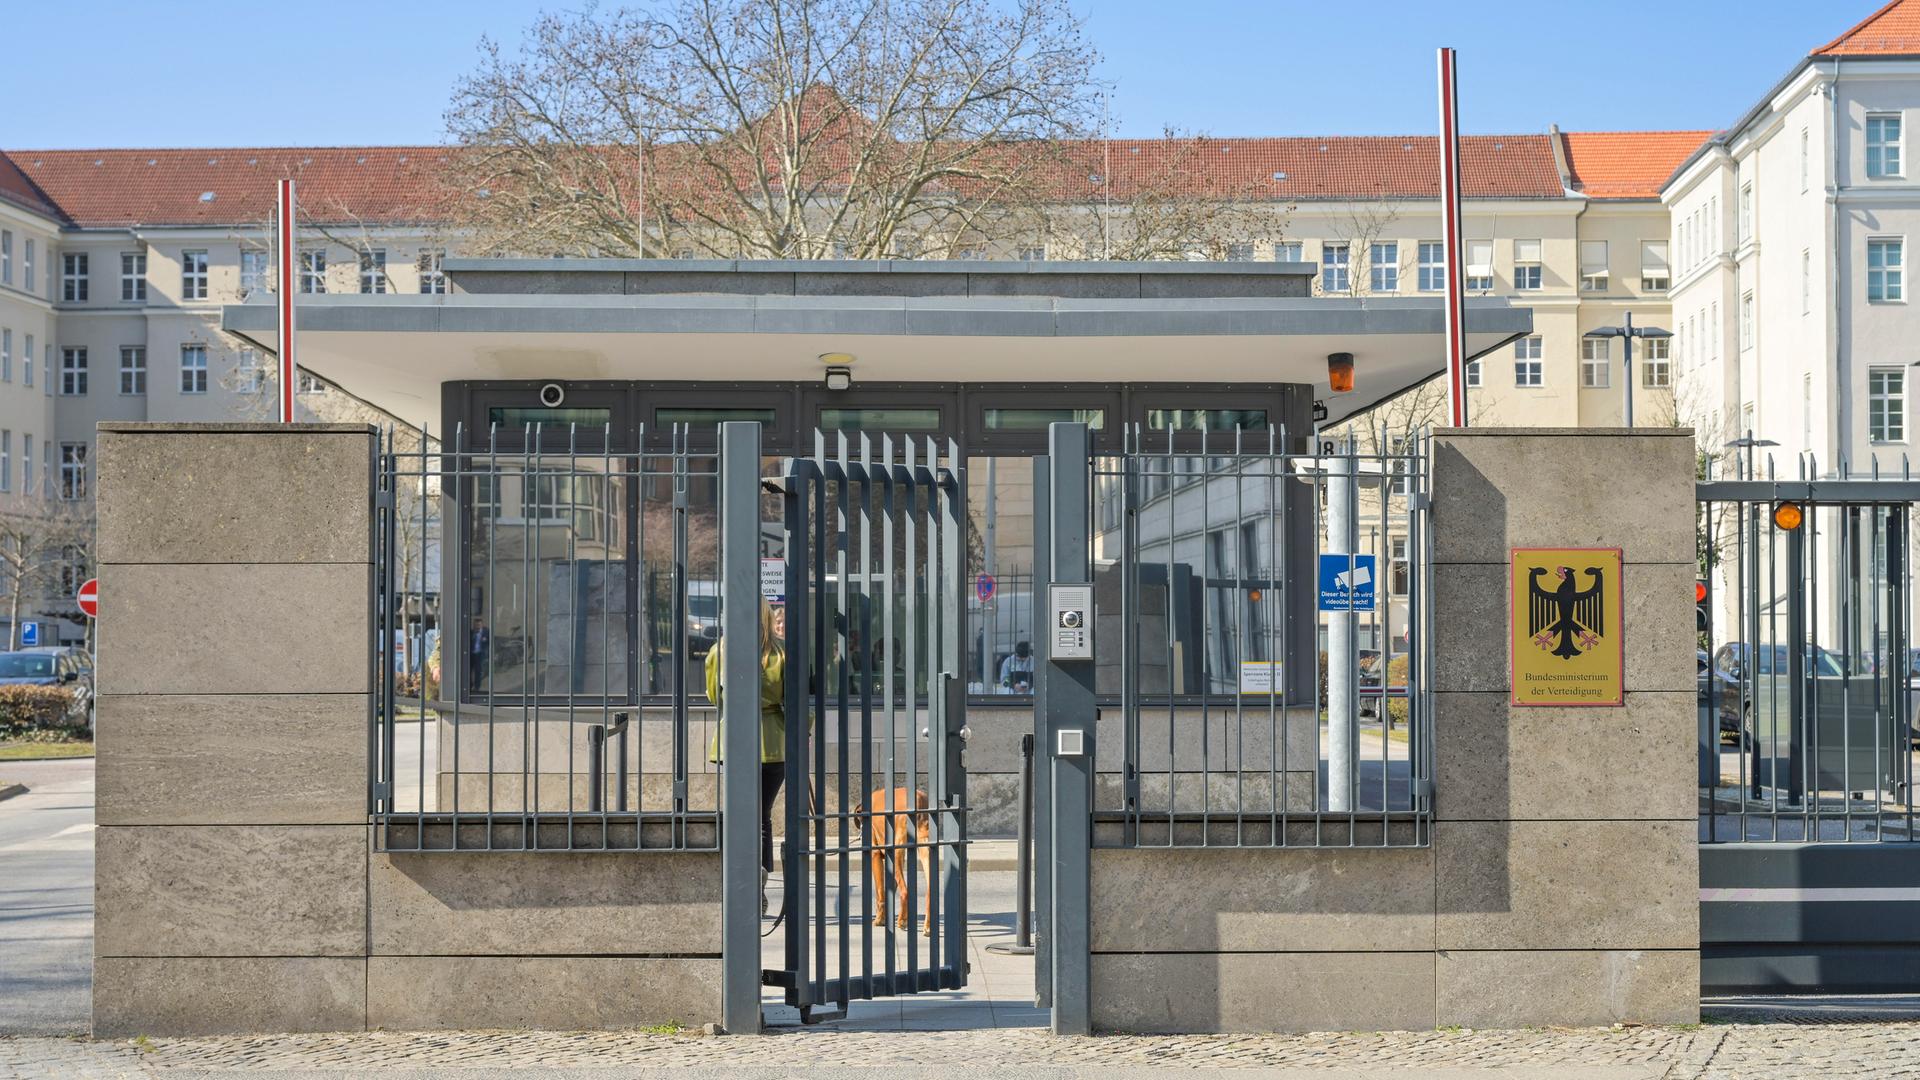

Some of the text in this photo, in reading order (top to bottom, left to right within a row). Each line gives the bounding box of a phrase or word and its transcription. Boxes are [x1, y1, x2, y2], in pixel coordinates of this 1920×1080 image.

[25, 624, 32, 634] P
[1525, 672, 1608, 681] Bundesministerium
[1531, 686, 1602, 697] der Verteidigung
